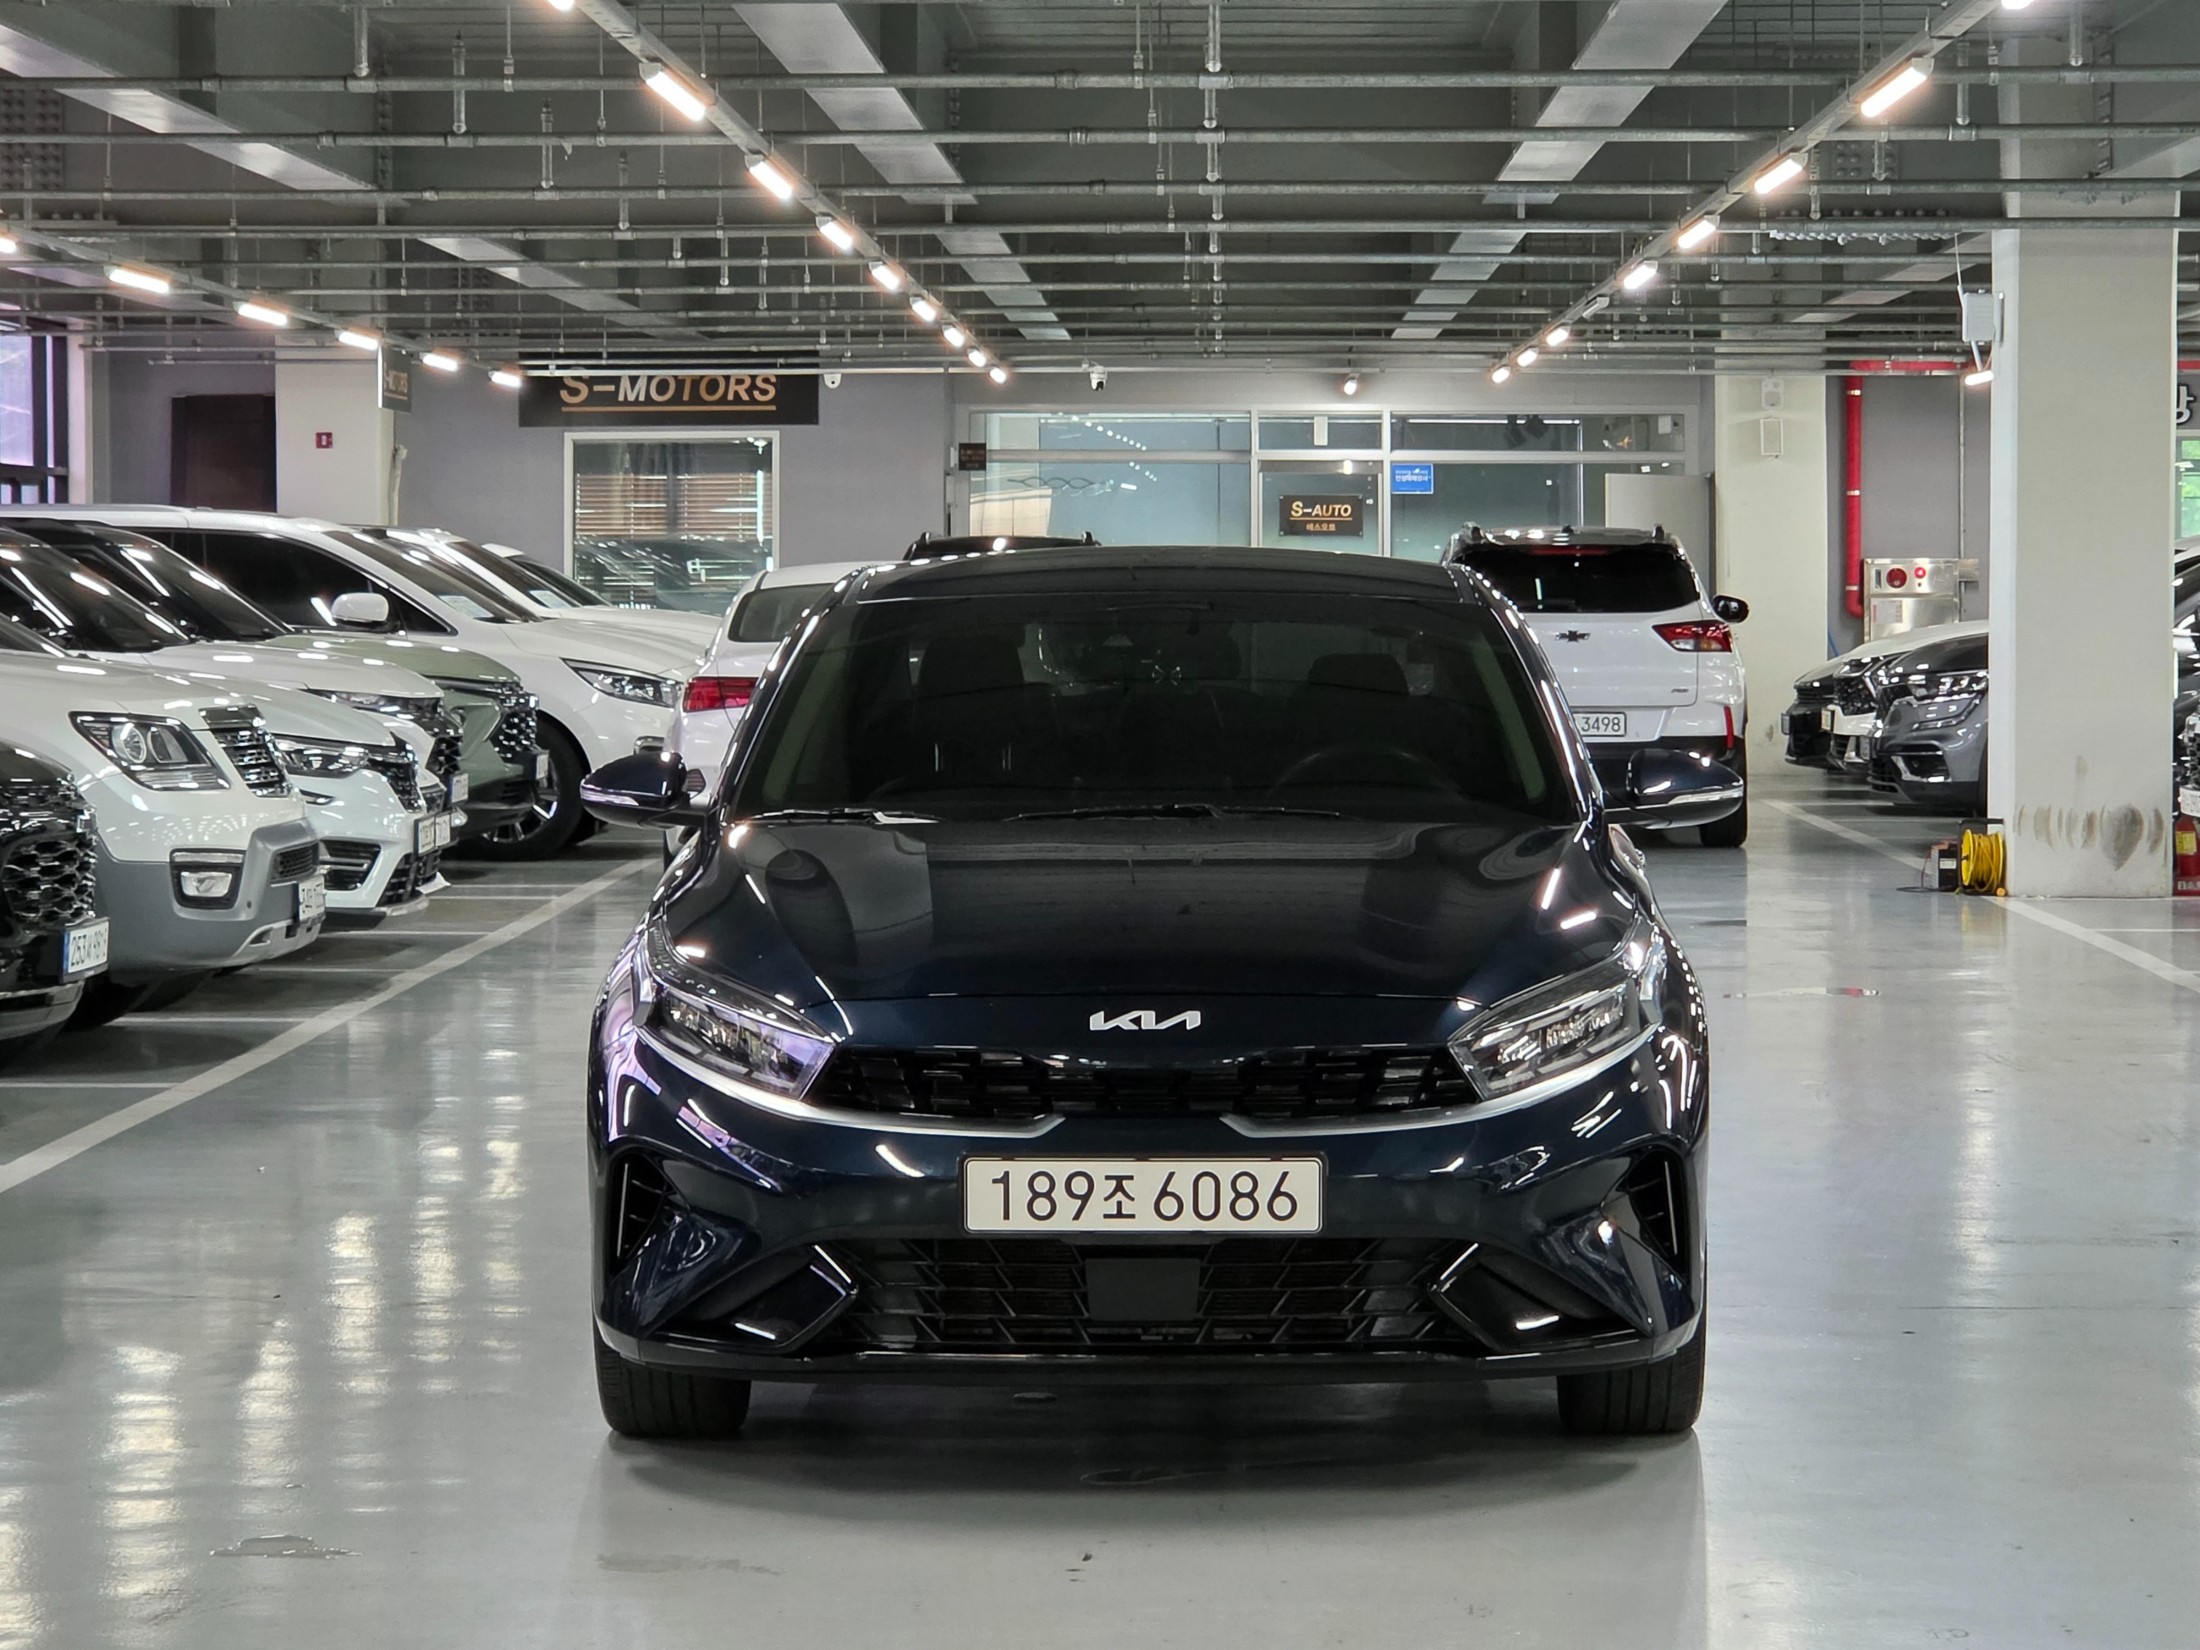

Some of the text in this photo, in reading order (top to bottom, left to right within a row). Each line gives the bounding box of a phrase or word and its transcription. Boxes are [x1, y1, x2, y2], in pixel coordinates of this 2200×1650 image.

[560, 367, 777, 404] S-MOTORS
[1291, 501, 1352, 517] S-AUTO
[1581, 716, 1621, 732] 3498
[1090, 1010, 1201, 1031] KIA
[991, 1170, 1298, 1222] 189조 6086
